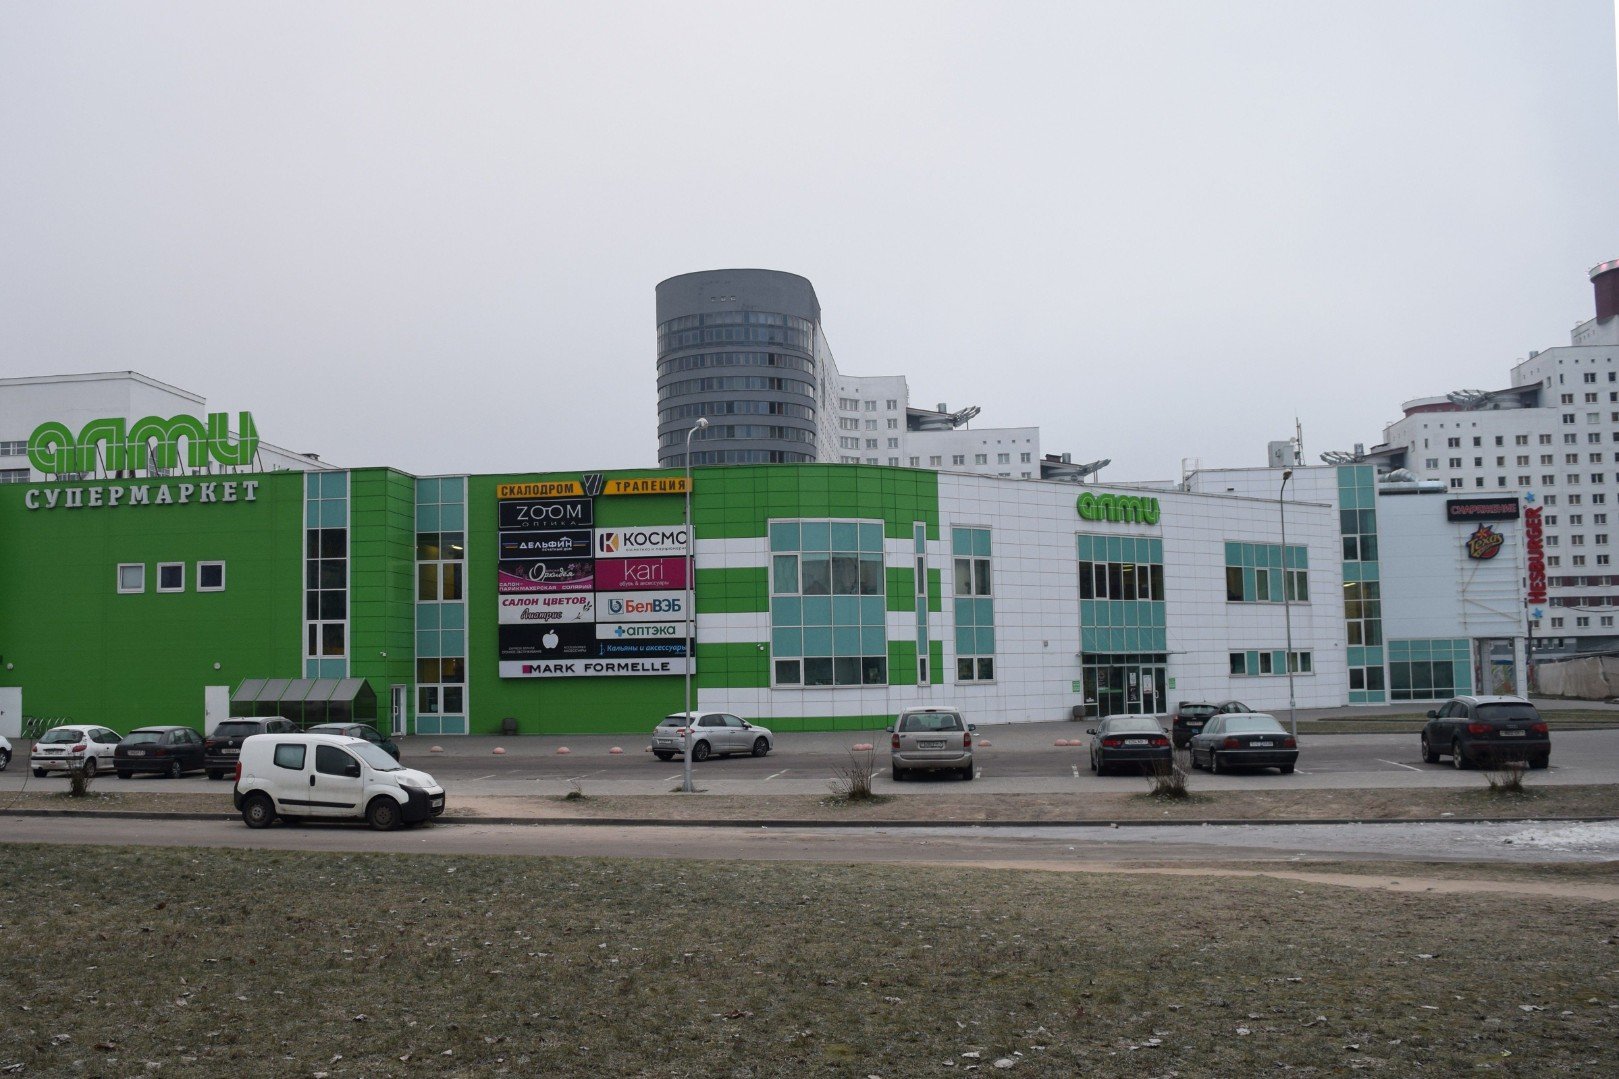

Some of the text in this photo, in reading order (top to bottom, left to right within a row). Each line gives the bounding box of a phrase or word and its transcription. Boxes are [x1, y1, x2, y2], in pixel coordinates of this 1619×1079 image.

[25, 481, 258, 509] СУПЕРМАРКЕТ
[501, 479, 686, 497] СКАЛОДРОМ ТРАПЕЦИЯ
[516, 504, 582, 520] ZOOM
[519, 540, 573, 549] ДЕЛЬФИН
[623, 531, 687, 546] КОСМО
[1525, 505, 1547, 604] HESBURGER
[624, 558, 663, 580] kari
[502, 597, 587, 607] САЛОН ЦВЕТОВ
[625, 599, 682, 613] БелВЭБ
[626, 625, 676, 636] аптэка
[531, 662, 670, 673] MARK FORMELLE
